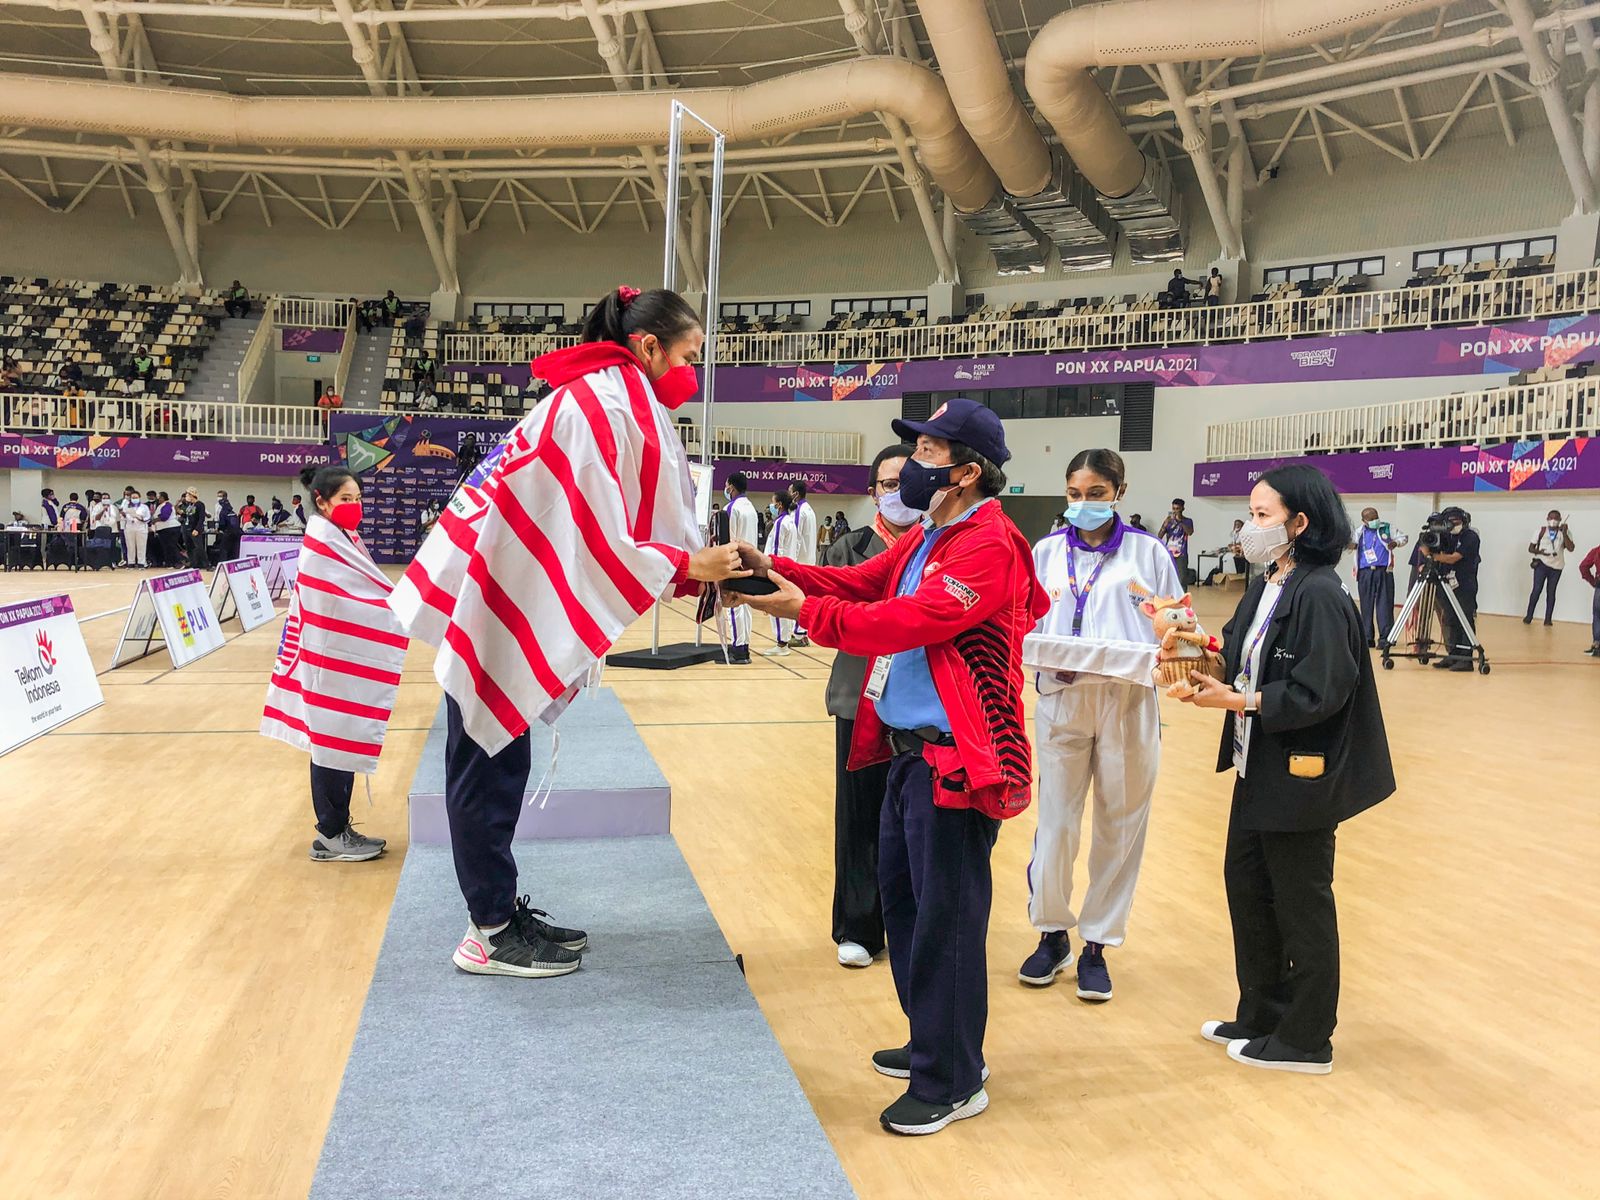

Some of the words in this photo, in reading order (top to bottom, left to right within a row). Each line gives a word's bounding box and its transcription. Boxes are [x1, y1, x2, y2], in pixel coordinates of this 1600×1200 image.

[1460, 341, 1501, 357] PON
[1508, 338, 1534, 354] XX
[1540, 331, 1600, 351] PAPU
[1291, 350, 1330, 360] TORANG
[1299, 348, 1337, 367] BISA!
[1055, 361, 1086, 375] PON
[1090, 360, 1109, 374] XX
[1113, 358, 1166, 373] PAPUA
[1168, 358, 1198, 371] 2021
[778, 377, 805, 389] PON
[808, 376, 826, 388] XX
[829, 374, 873, 387] PAPUA
[875, 374, 898, 386] 2021
[3, 444, 30, 455] PON
[33, 446, 50, 456] XX
[53, 446, 96, 457] PAPUA
[97, 448, 120, 458] 2021
[260, 453, 284, 464] PON
[287, 454, 302, 464] XX
[305, 455, 330, 465] PAP
[1461, 461, 1485, 474] PON
[1488, 460, 1503, 473] XX
[1507, 459, 1550, 472] PAPUA
[1551, 457, 1577, 471] 2021
[762, 471, 774, 480] XX
[776, 472, 808, 481] PAPUA
[809, 473, 827, 482] 2021
[944, 576, 975, 598] TORANG
[946, 584, 979, 609] BISA!
[8, 610, 17, 622] XX
[15, 606, 33, 620] PAPUA
[187, 606, 209, 634] PLN
[15, 666, 44, 686] Telkom
[25, 680, 61, 704] Indonesia
